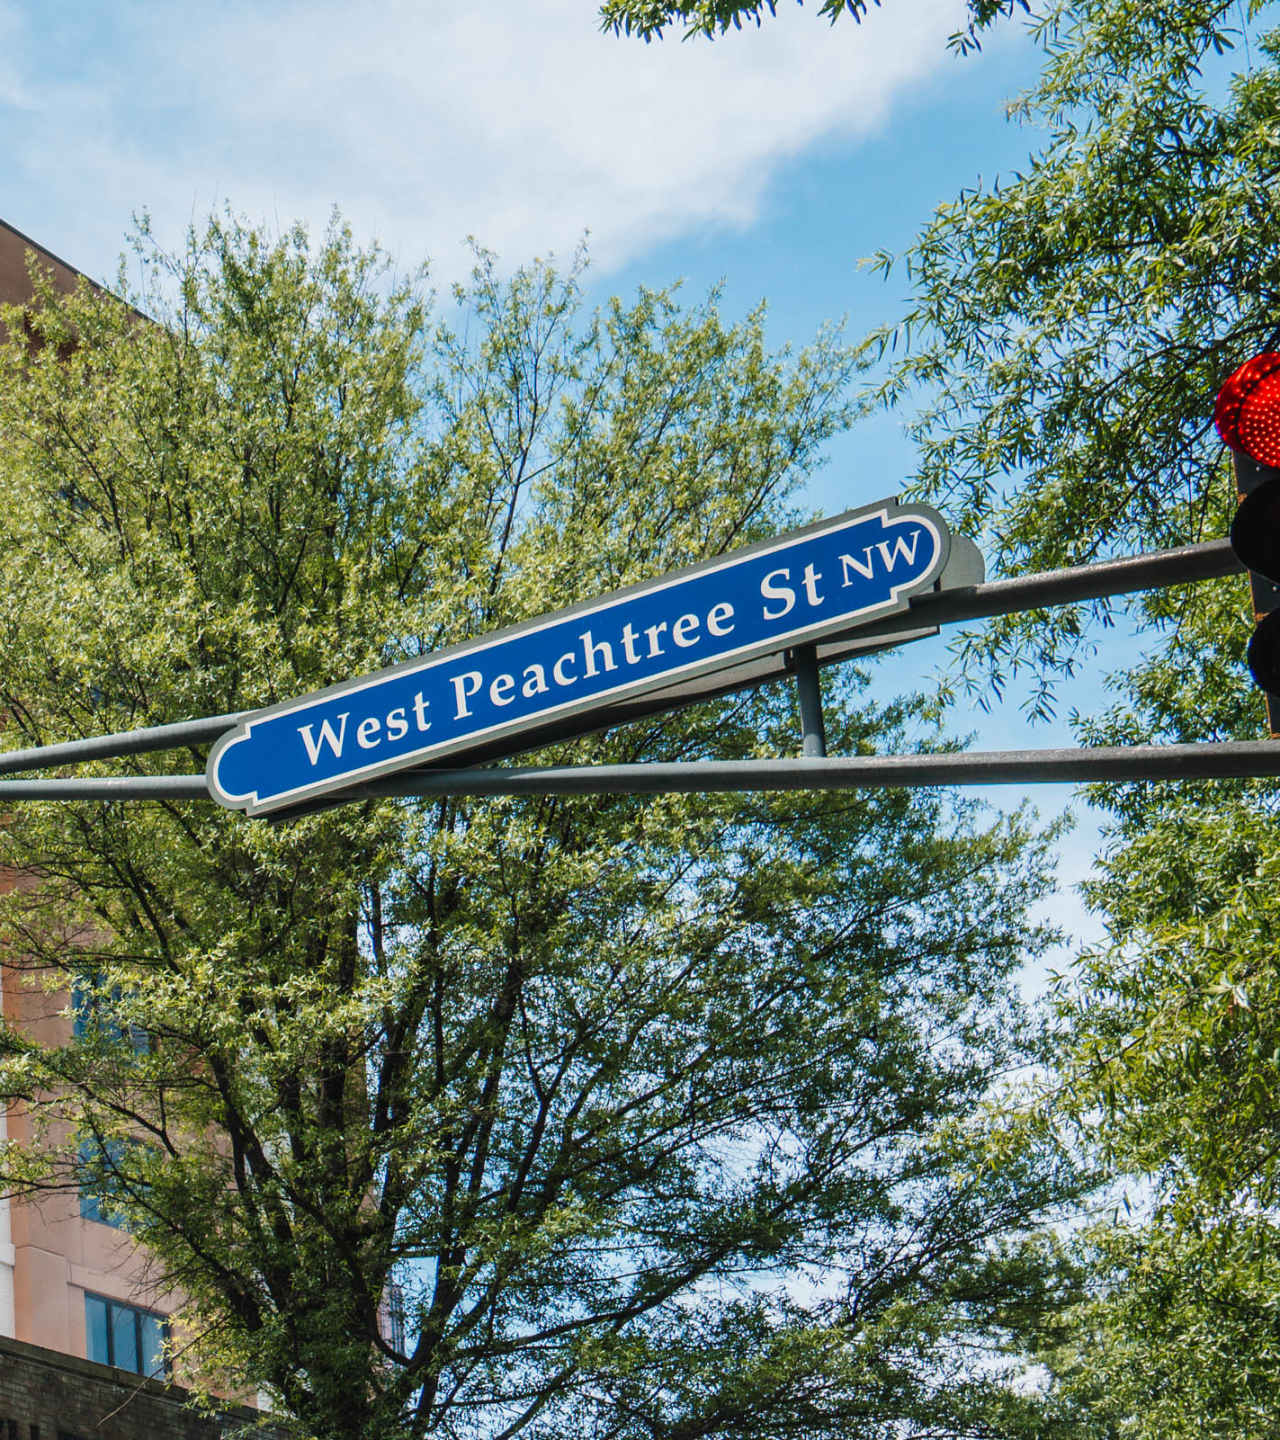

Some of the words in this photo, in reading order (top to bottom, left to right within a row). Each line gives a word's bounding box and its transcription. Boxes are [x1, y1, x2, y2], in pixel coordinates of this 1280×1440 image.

[297, 692, 433, 768] West
[449, 600, 736, 722] Peachtree
[760, 563, 825, 623] St
[839, 529, 922, 590] NW
